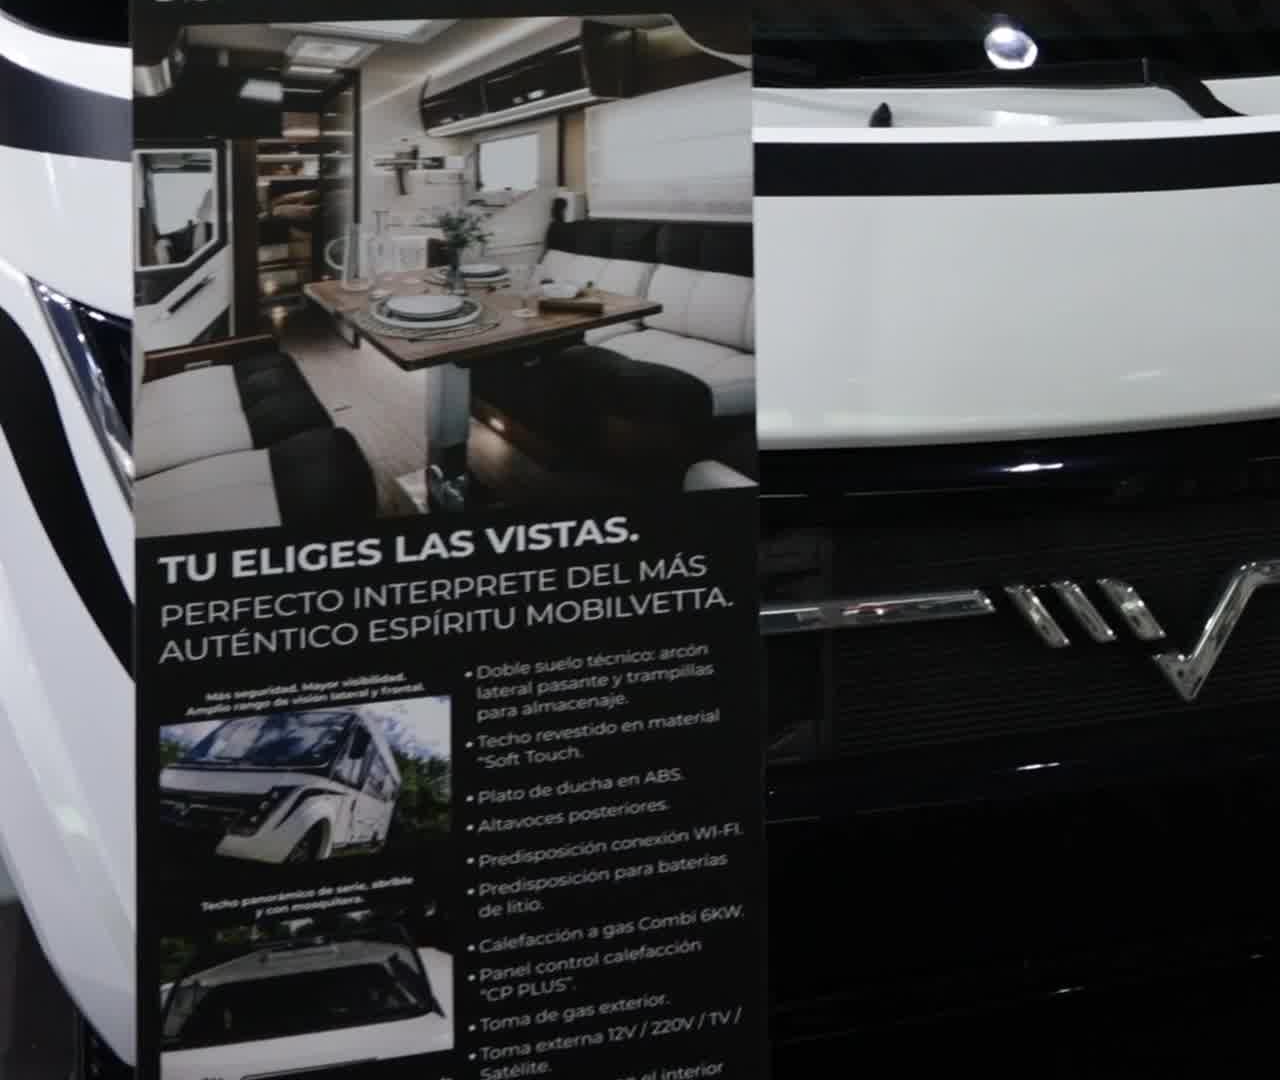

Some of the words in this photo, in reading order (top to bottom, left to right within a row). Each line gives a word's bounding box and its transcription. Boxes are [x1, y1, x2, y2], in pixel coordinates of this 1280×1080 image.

[158, 553, 217, 584] TU
[232, 538, 382, 578] ELIGES
[396, 530, 475, 563] LAS
[485, 516, 640, 554] VISTAS.
[161, 589, 344, 628] PERFECTO
[354, 569, 557, 609] INTERPRETE
[568, 563, 631, 589] DEL
[639, 552, 708, 582] MÁS
[158, 619, 359, 664] AUTÉNTICO
[369, 607, 516, 643] ESPÍRITU
[526, 586, 734, 627] MOBILVETTA.
[477, 661, 531, 680] Doble
[535, 656, 583, 672] suelo
[587, 649, 655, 669] técnico:
[659, 643, 709, 661] arcón
[477, 681, 533, 700] lateral
[537, 673, 609, 696] pasante
[612, 674, 623, 688] y
[627, 663, 715, 684] trampillas
[477, 705, 518, 724] para
[521, 693, 630, 717] almacenaje.
[477, 732, 532, 749] Techo
[535, 721, 617, 743] revestido
[621, 721, 644, 733] en
[648, 708, 721, 729] material
[526, 745, 584, 765] Touch.
[478, 786, 525, 804] Plato
[529, 783, 552, 800] de
[556, 774, 613, 796] ducha
[617, 775, 640, 788] en
[644, 767, 686, 785] ABS.
[477, 812, 564, 834] Altavoces
[568, 800, 671, 826] posteriores.
[478, 840, 608, 867] Predisposición
[611, 829, 690, 852] conexión
[479, 869, 610, 896] Predisposición
[614, 863, 654, 882] para
[658, 853, 728, 873] baterías
[478, 902, 503, 918] de
[506, 897, 544, 914] litio.
[479, 928, 584, 953] Calefacción
[587, 927, 599, 938] a
[602, 919, 635, 939] gas
[638, 911, 697, 931] Combi
[700, 904, 745, 922] 6KW.
[479, 962, 531, 981] Panel
[535, 952, 599, 973] control
[603, 940, 702, 965] calefacción
[480, 1013, 531, 1032] Toma
[535, 1008, 559, 1024] de
[563, 1004, 595, 1022] gas
[599, 993, 671, 1015] exterior.
[480, 1043, 531, 1061] Toma
[535, 1032, 604, 1052] externa
[607, 1025, 637, 1042] 12V
[639, 1023, 648, 1038] /
[651, 1015, 695, 1036] 220V
[697, 1012, 706, 1030] /
[708, 1010, 730, 1025] TV
[734, 1007, 742, 1025] /
[661, 1061, 724, 1080] interior
